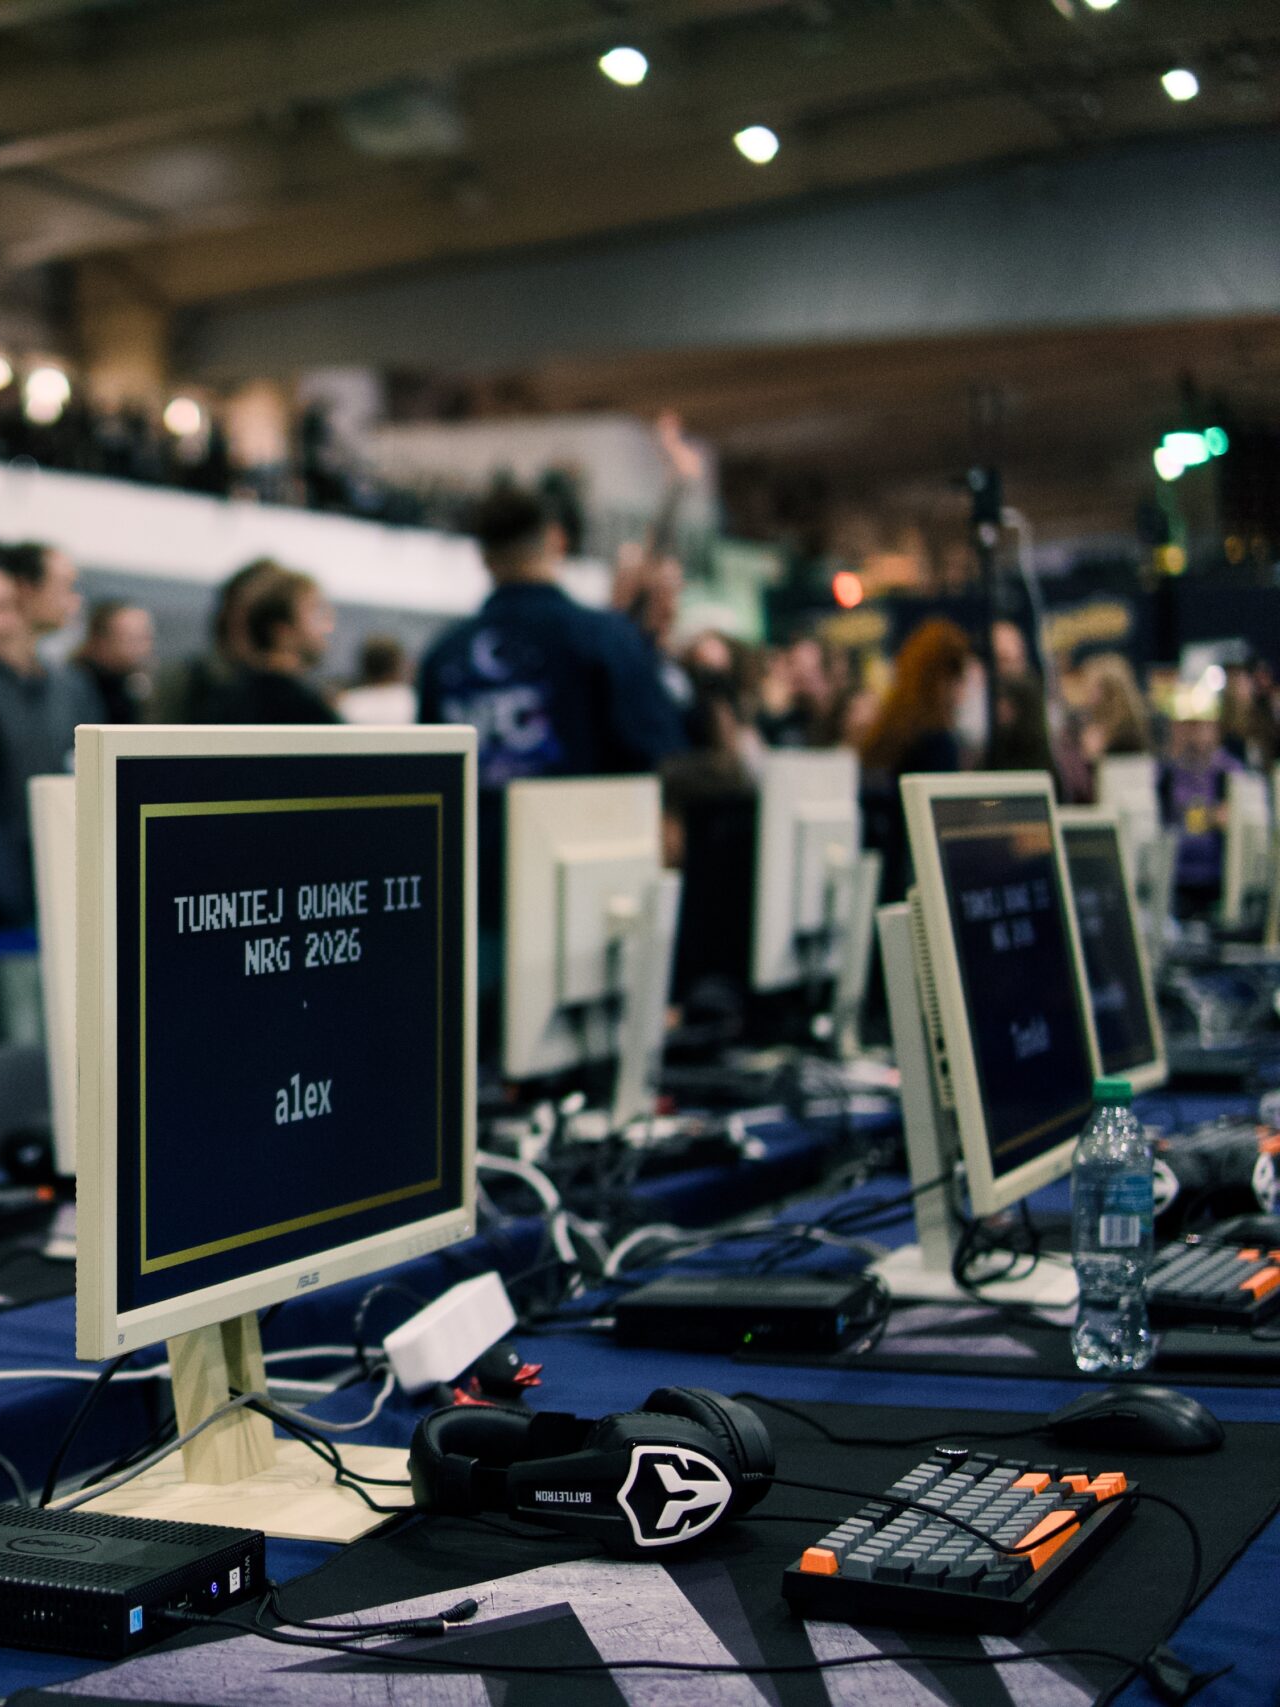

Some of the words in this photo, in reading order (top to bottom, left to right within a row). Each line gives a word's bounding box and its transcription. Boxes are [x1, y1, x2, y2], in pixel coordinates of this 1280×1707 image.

[174, 887, 283, 933] TURNIEJ
[298, 880, 369, 920] QUAKE
[384, 876, 421, 911] III
[245, 936, 290, 976] NRG
[305, 928, 362, 968] 2026
[535, 1490, 592, 1502] BATTLETRON
